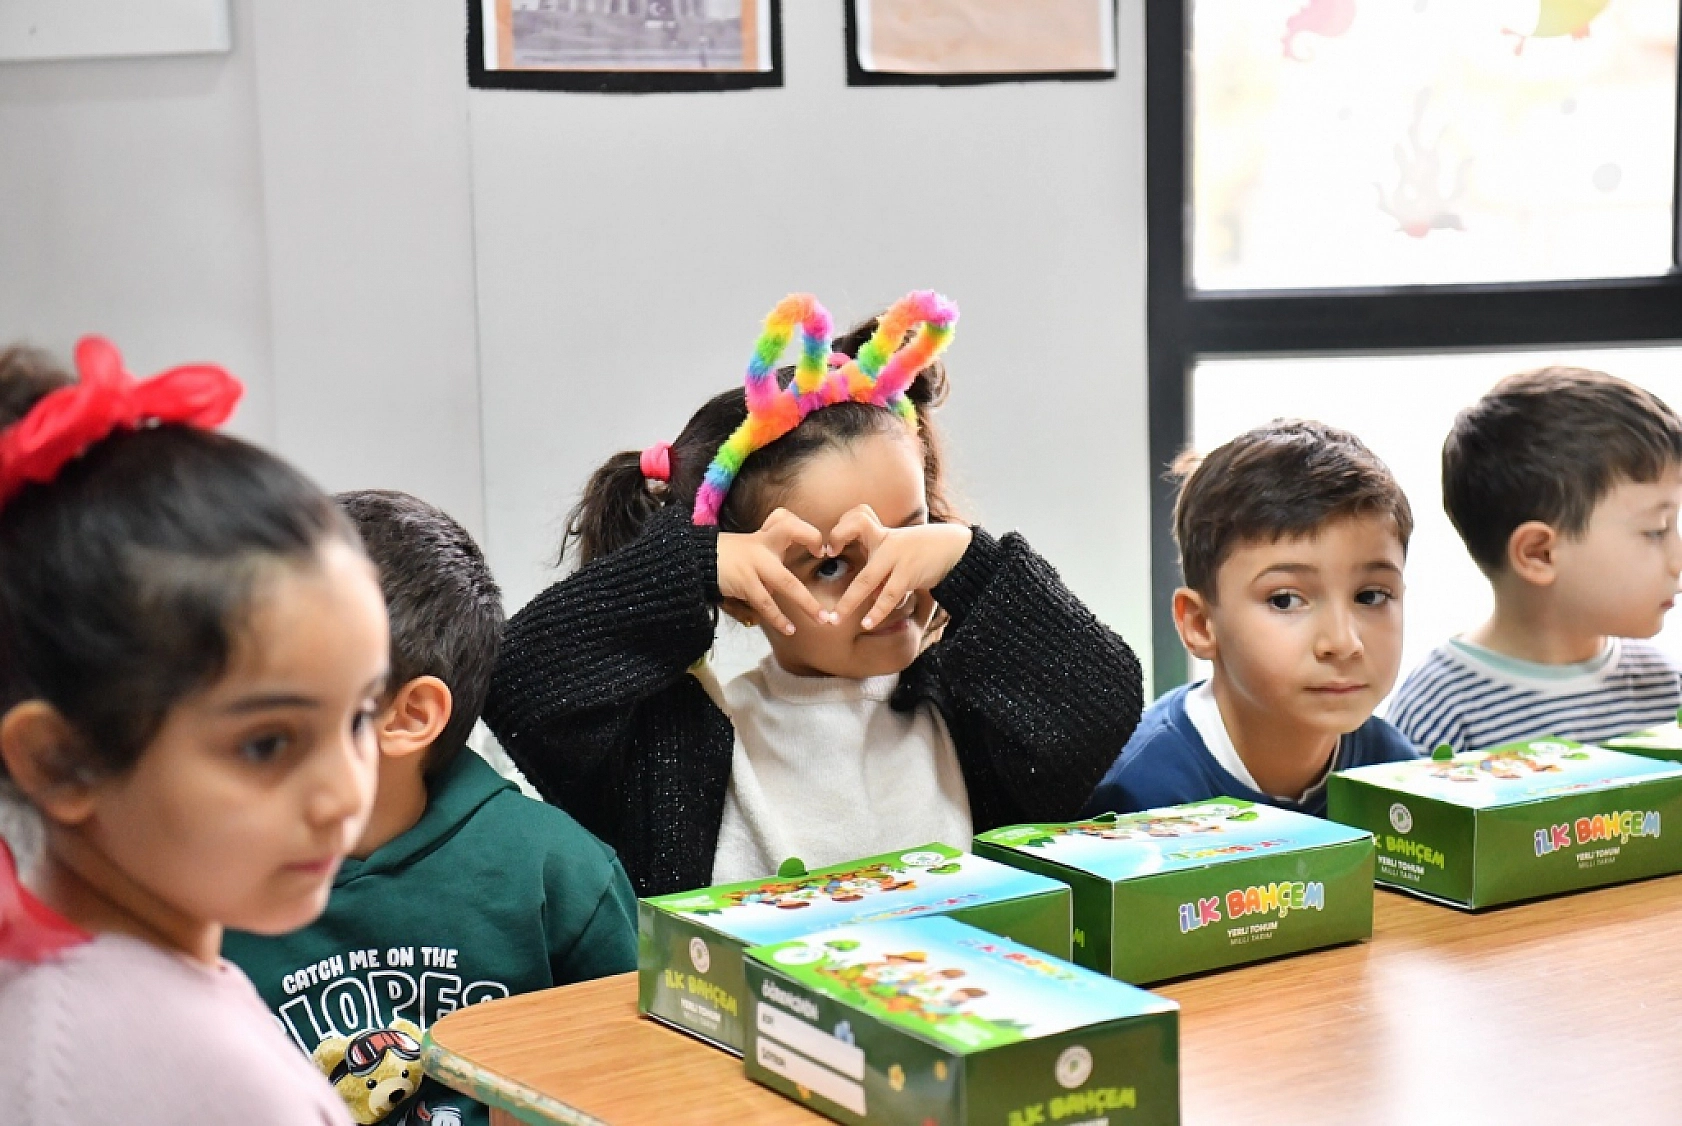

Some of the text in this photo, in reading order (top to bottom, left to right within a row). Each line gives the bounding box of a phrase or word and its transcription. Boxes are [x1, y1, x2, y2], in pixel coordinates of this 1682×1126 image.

[1575, 811, 1661, 844] BAHÇEM
[1386, 835, 1445, 870] BAHÇEM
[1226, 881, 1325, 919] BAHÇEM
[281, 947, 459, 994] CATCH ME ON THE
